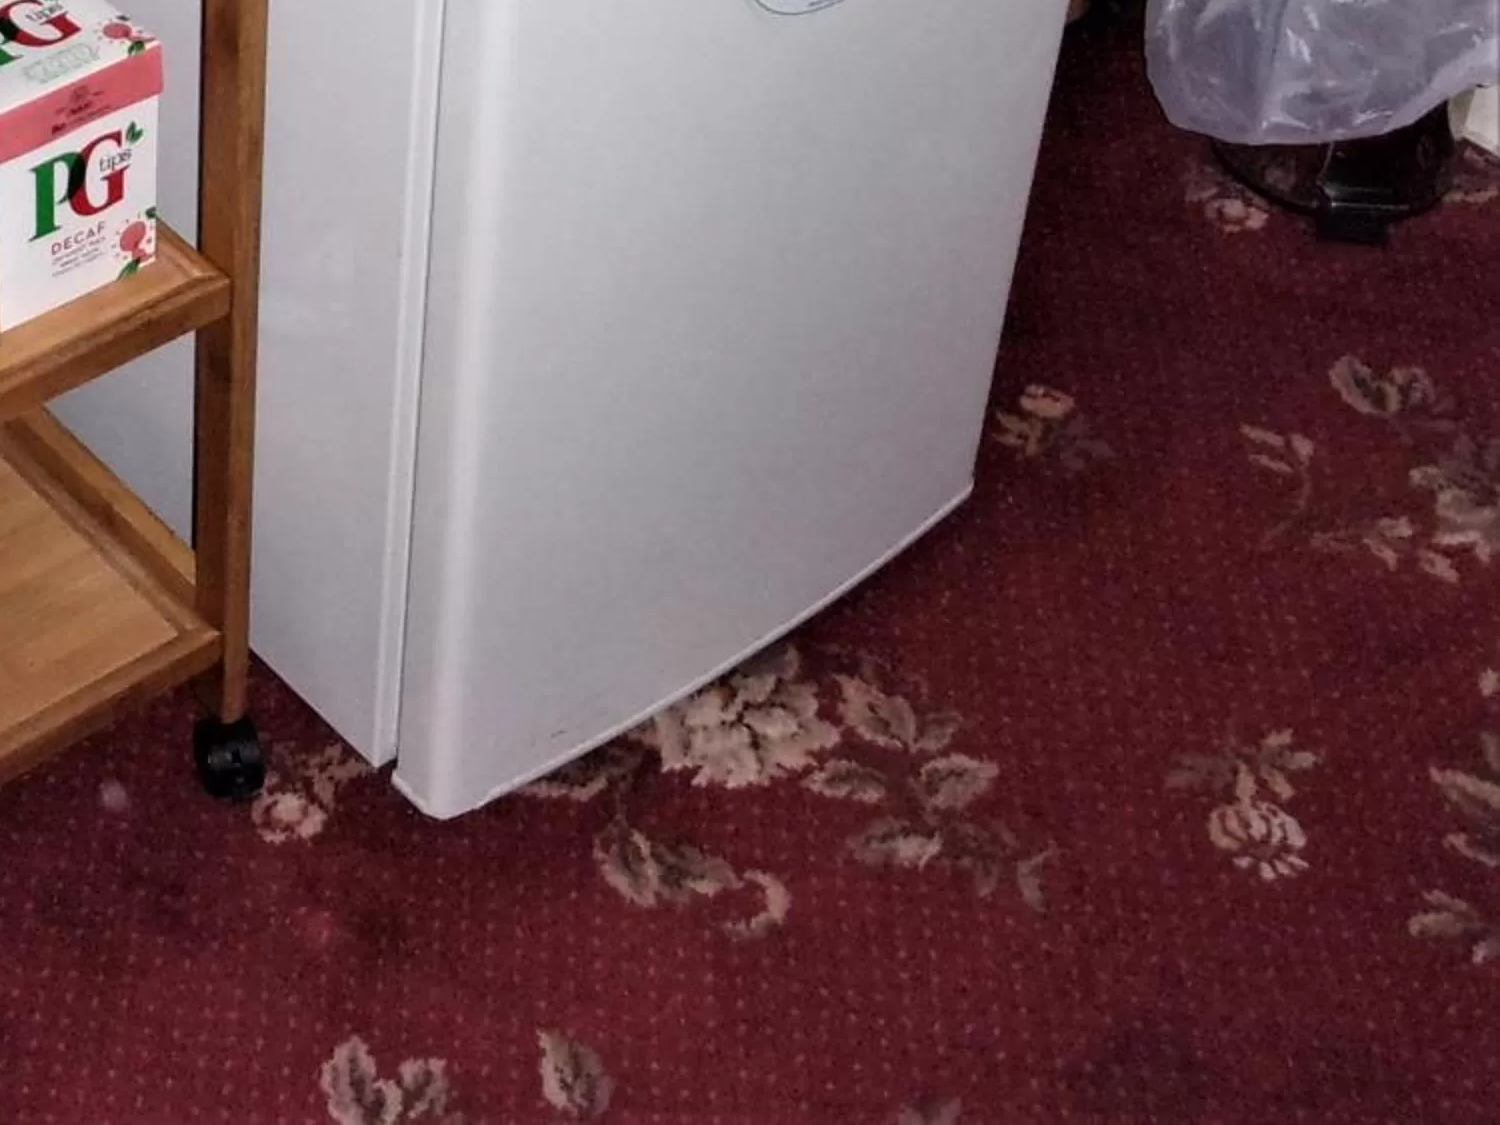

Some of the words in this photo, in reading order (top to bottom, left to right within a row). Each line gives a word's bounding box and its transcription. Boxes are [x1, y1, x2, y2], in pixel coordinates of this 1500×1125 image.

[29, 128, 131, 242] PG
[99, 149, 133, 174] tips
[51, 221, 106, 256] DECAF
